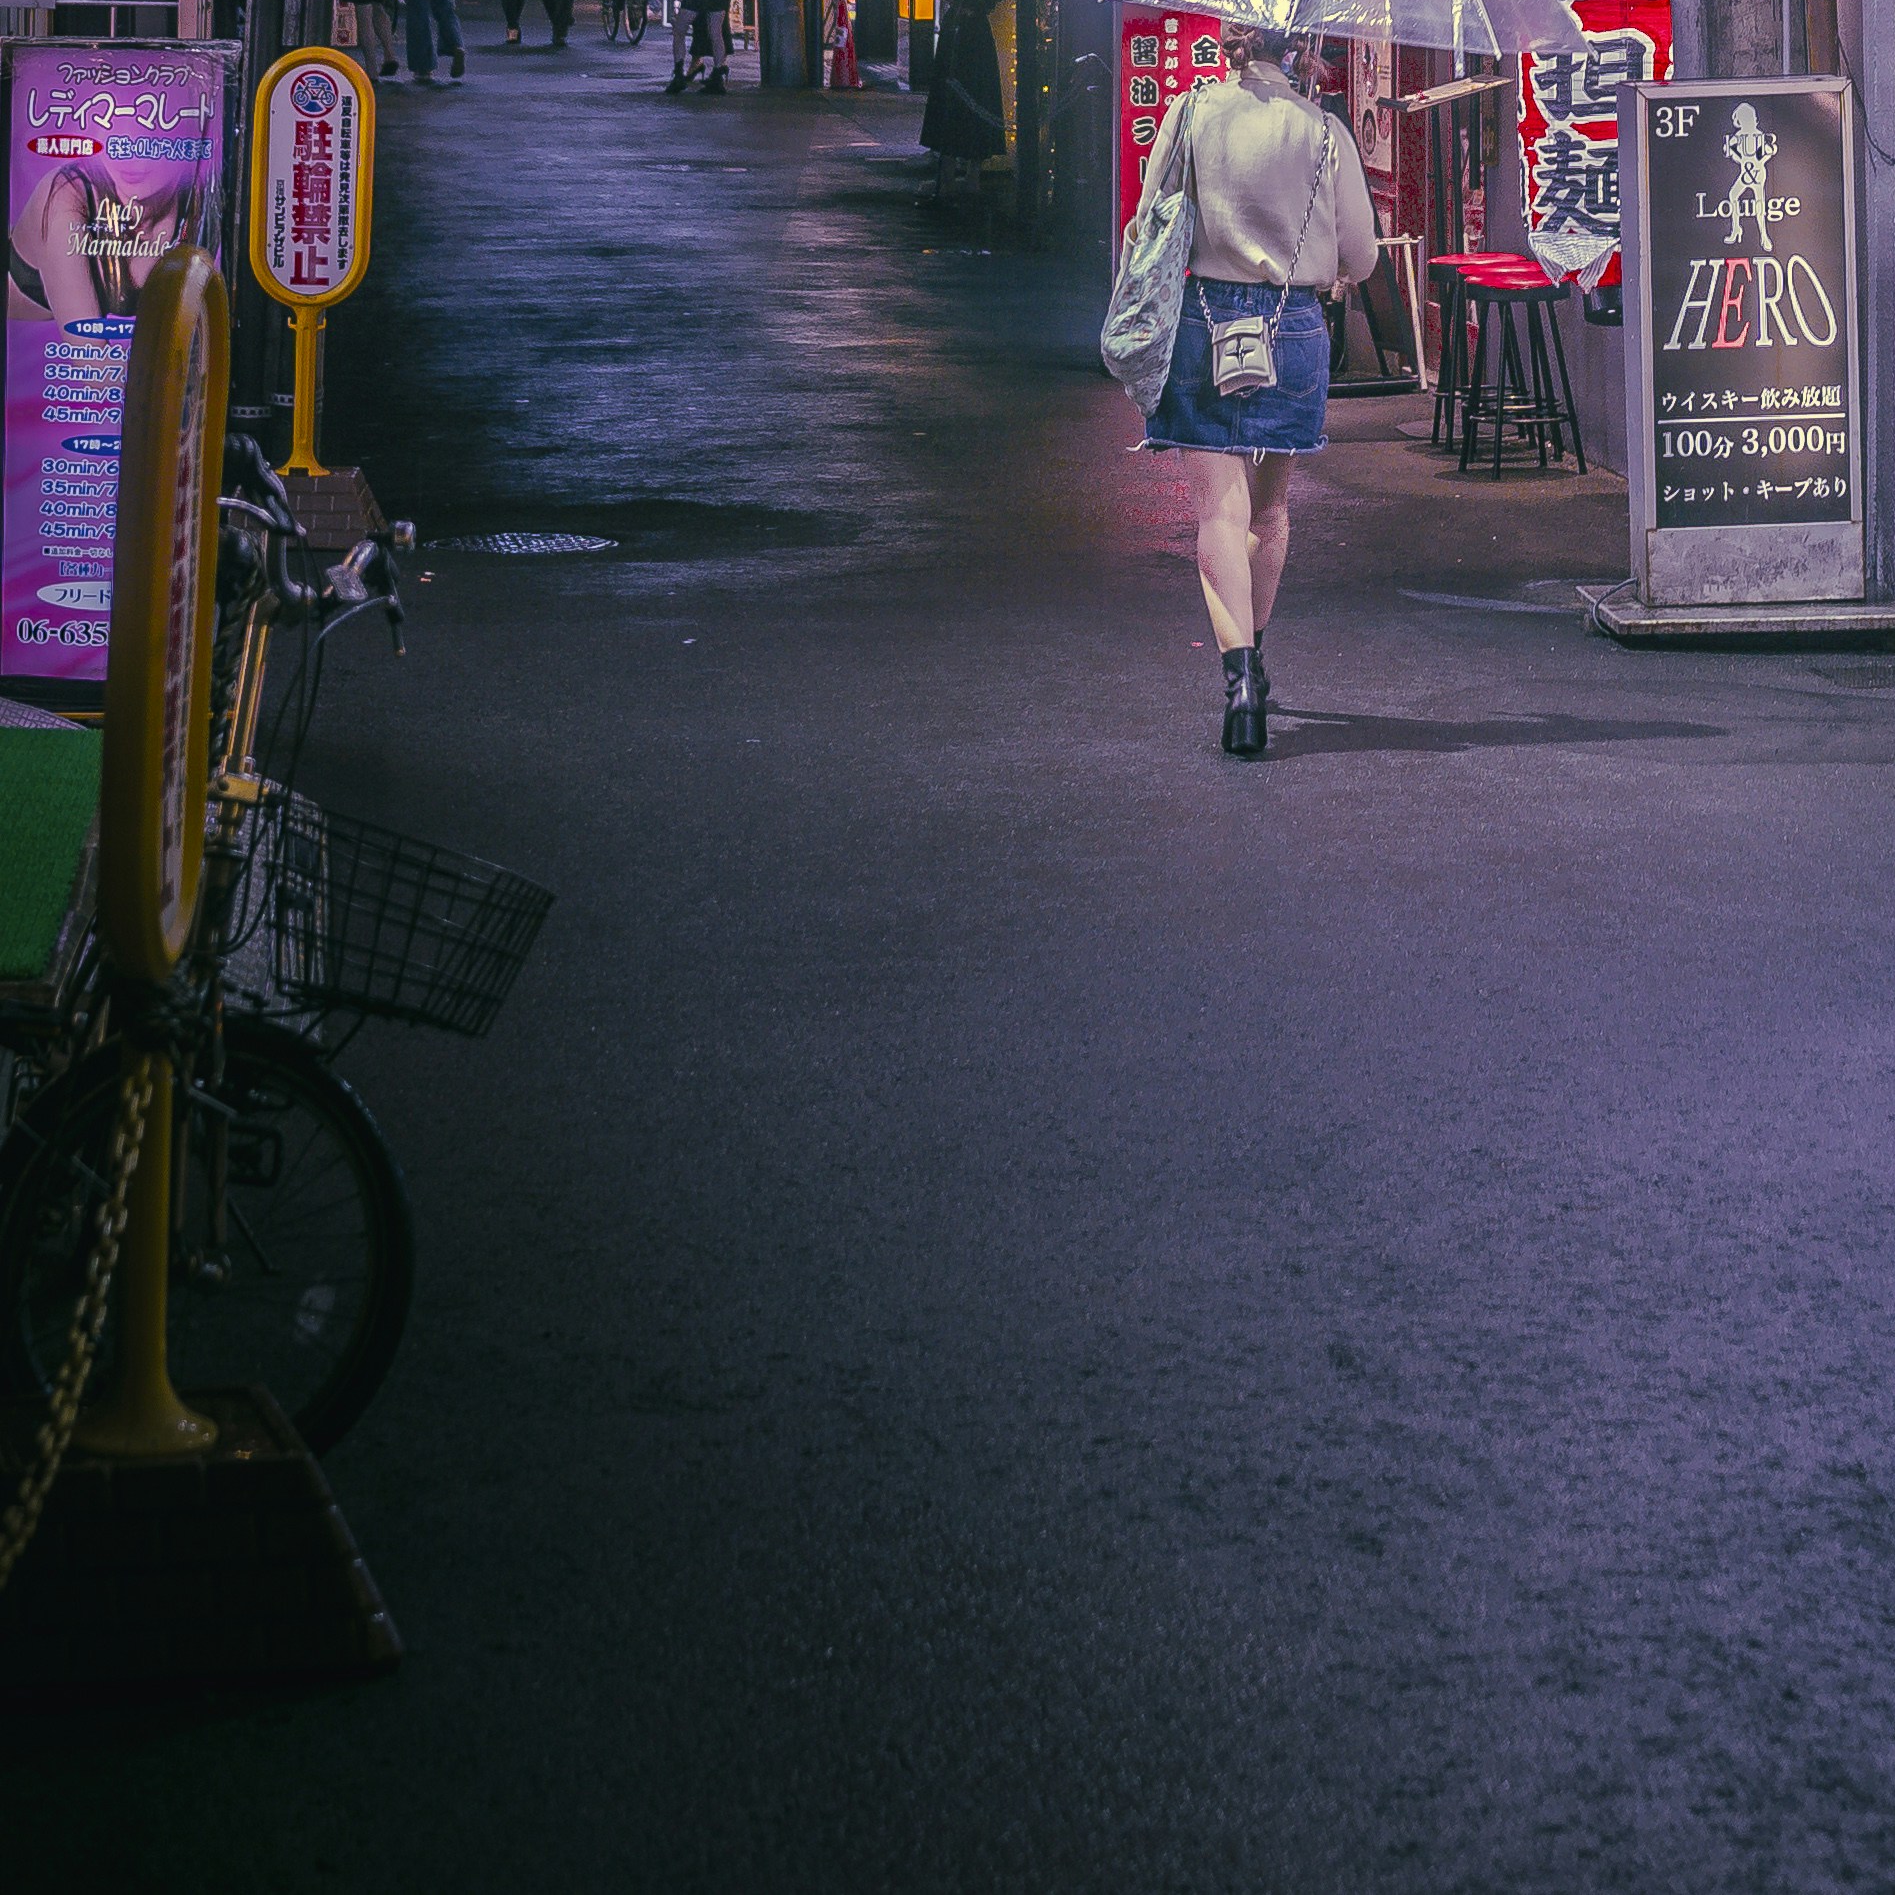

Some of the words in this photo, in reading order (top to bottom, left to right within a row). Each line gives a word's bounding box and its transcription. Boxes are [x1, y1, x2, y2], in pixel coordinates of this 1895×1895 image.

[1655, 106, 1700, 139] 3F
[290, 119, 334, 287] 駐輪禁止
[1696, 193, 1801, 230] Lounge
[1663, 254, 1838, 352] HERO
[1661, 384, 1842, 410] ウイスキー飲み放題
[1662, 428, 1734, 459] 100分
[1741, 423, 1846, 457] 3,000円
